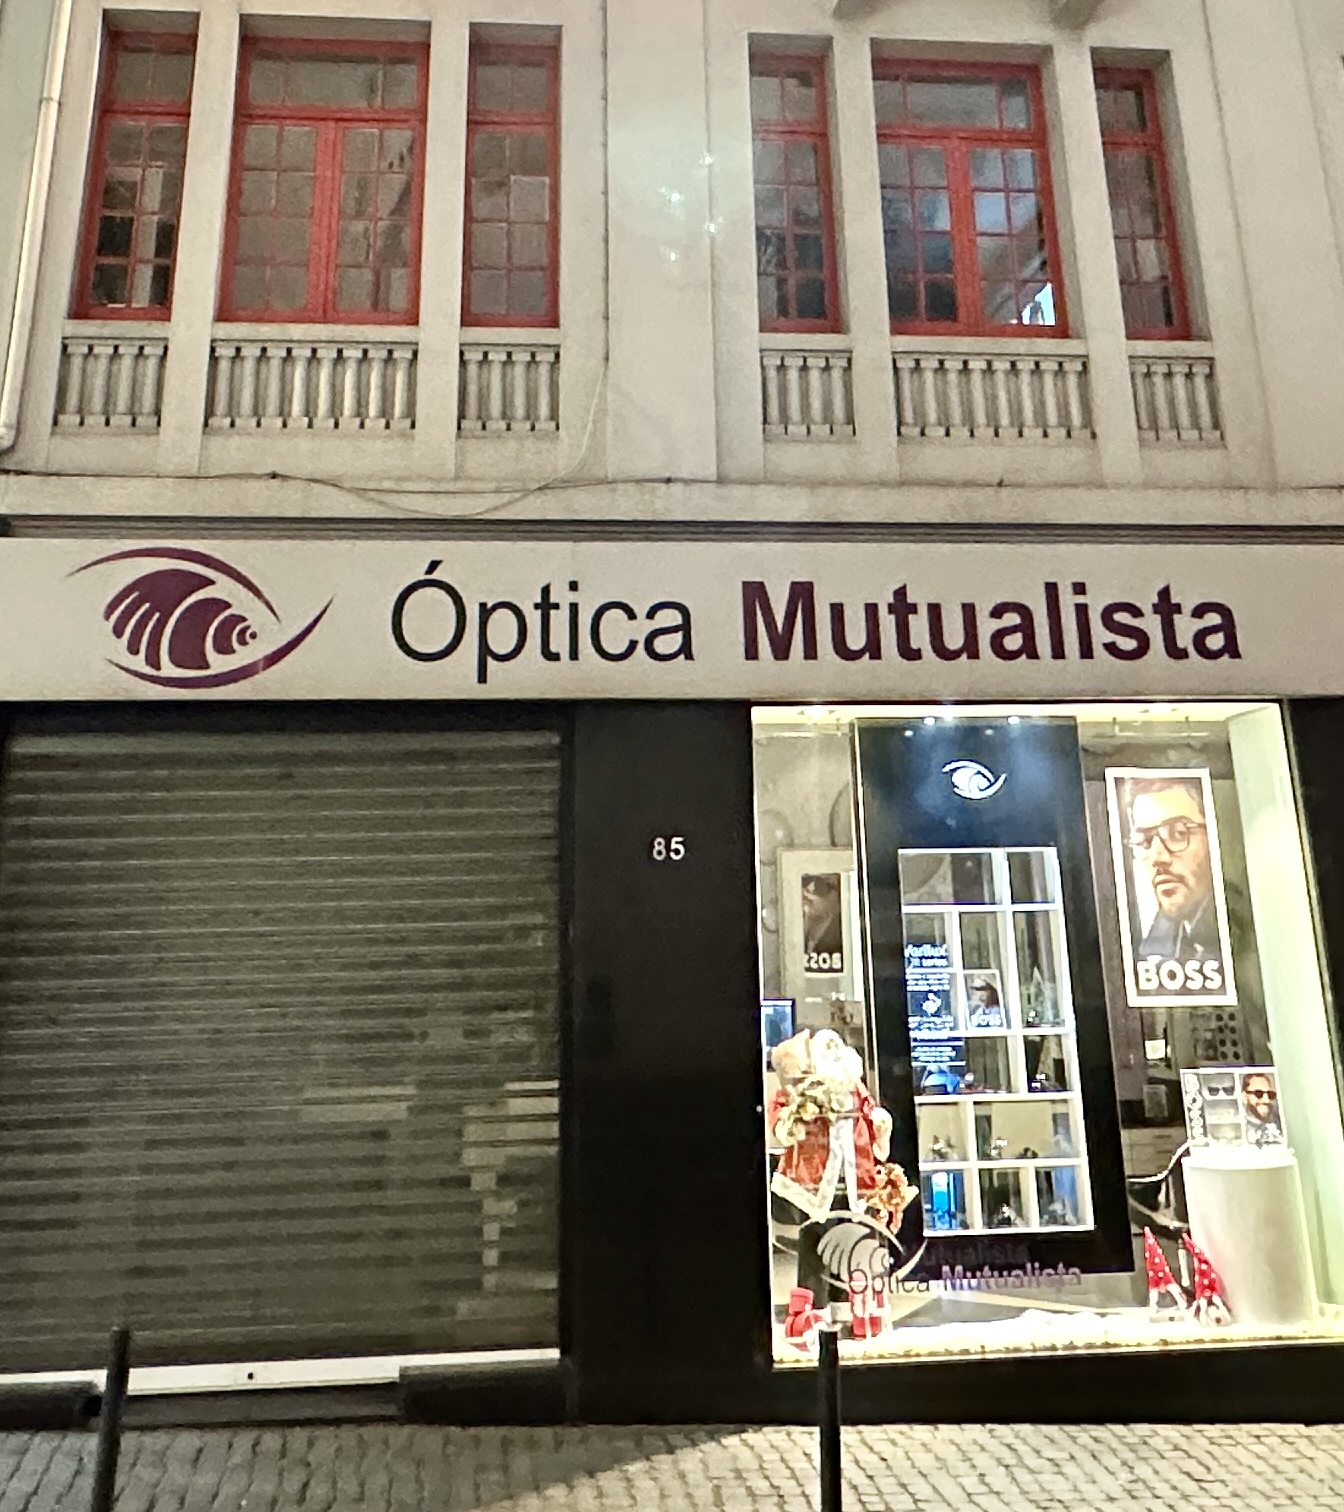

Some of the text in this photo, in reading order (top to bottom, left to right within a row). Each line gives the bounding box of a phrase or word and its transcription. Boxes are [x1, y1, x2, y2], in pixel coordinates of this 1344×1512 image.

[391, 560, 1242, 685] Óptica Mutualista
[652, 836, 686, 861] 85
[1136, 959, 1223, 991] BOSS
[941, 1261, 1082, 1292] Mutualista
